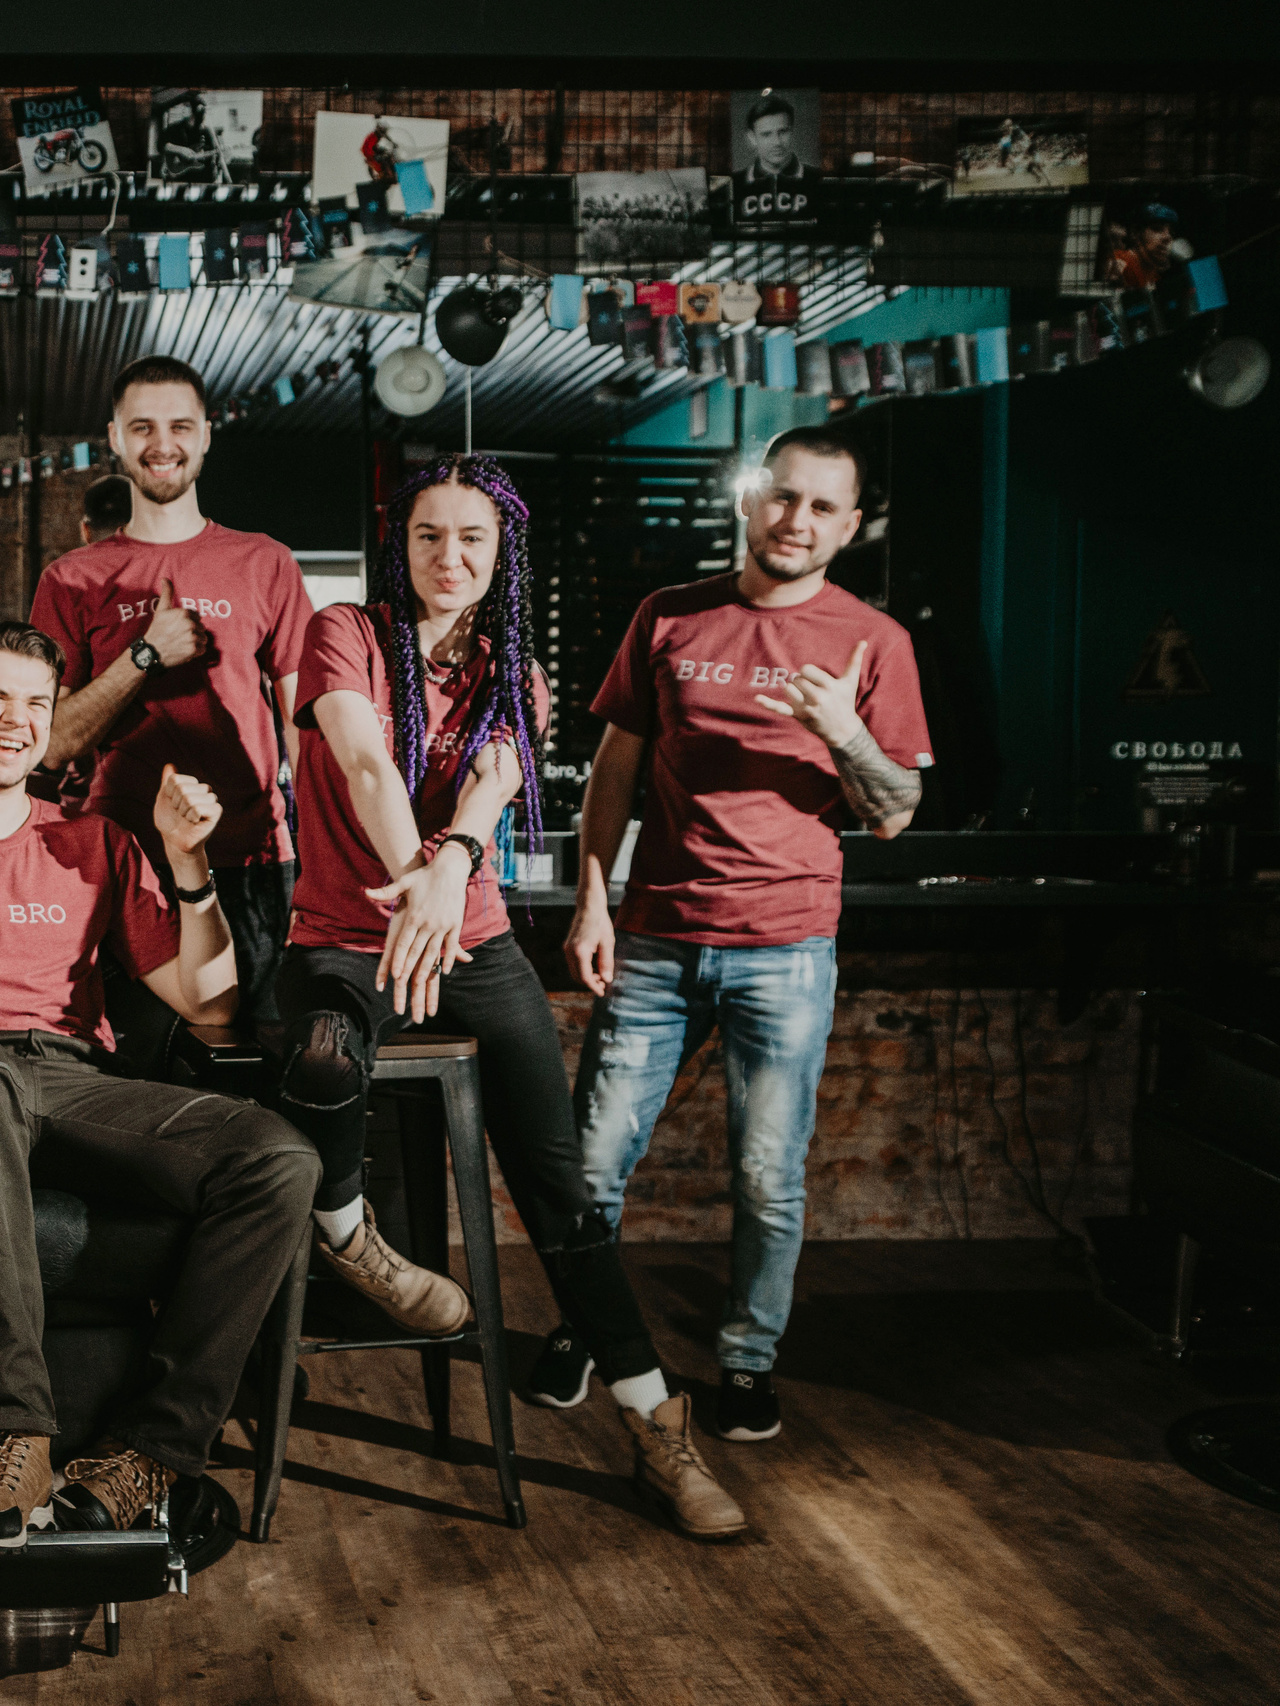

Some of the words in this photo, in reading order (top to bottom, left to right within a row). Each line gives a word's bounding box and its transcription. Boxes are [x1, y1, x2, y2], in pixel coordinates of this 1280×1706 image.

[23, 95, 88, 120] ROYAL
[741, 192, 808, 216] СССР
[675, 659, 735, 685] BIG
[1109, 740, 1243, 760] СВОБОДА
[7, 902, 67, 925] BRO
